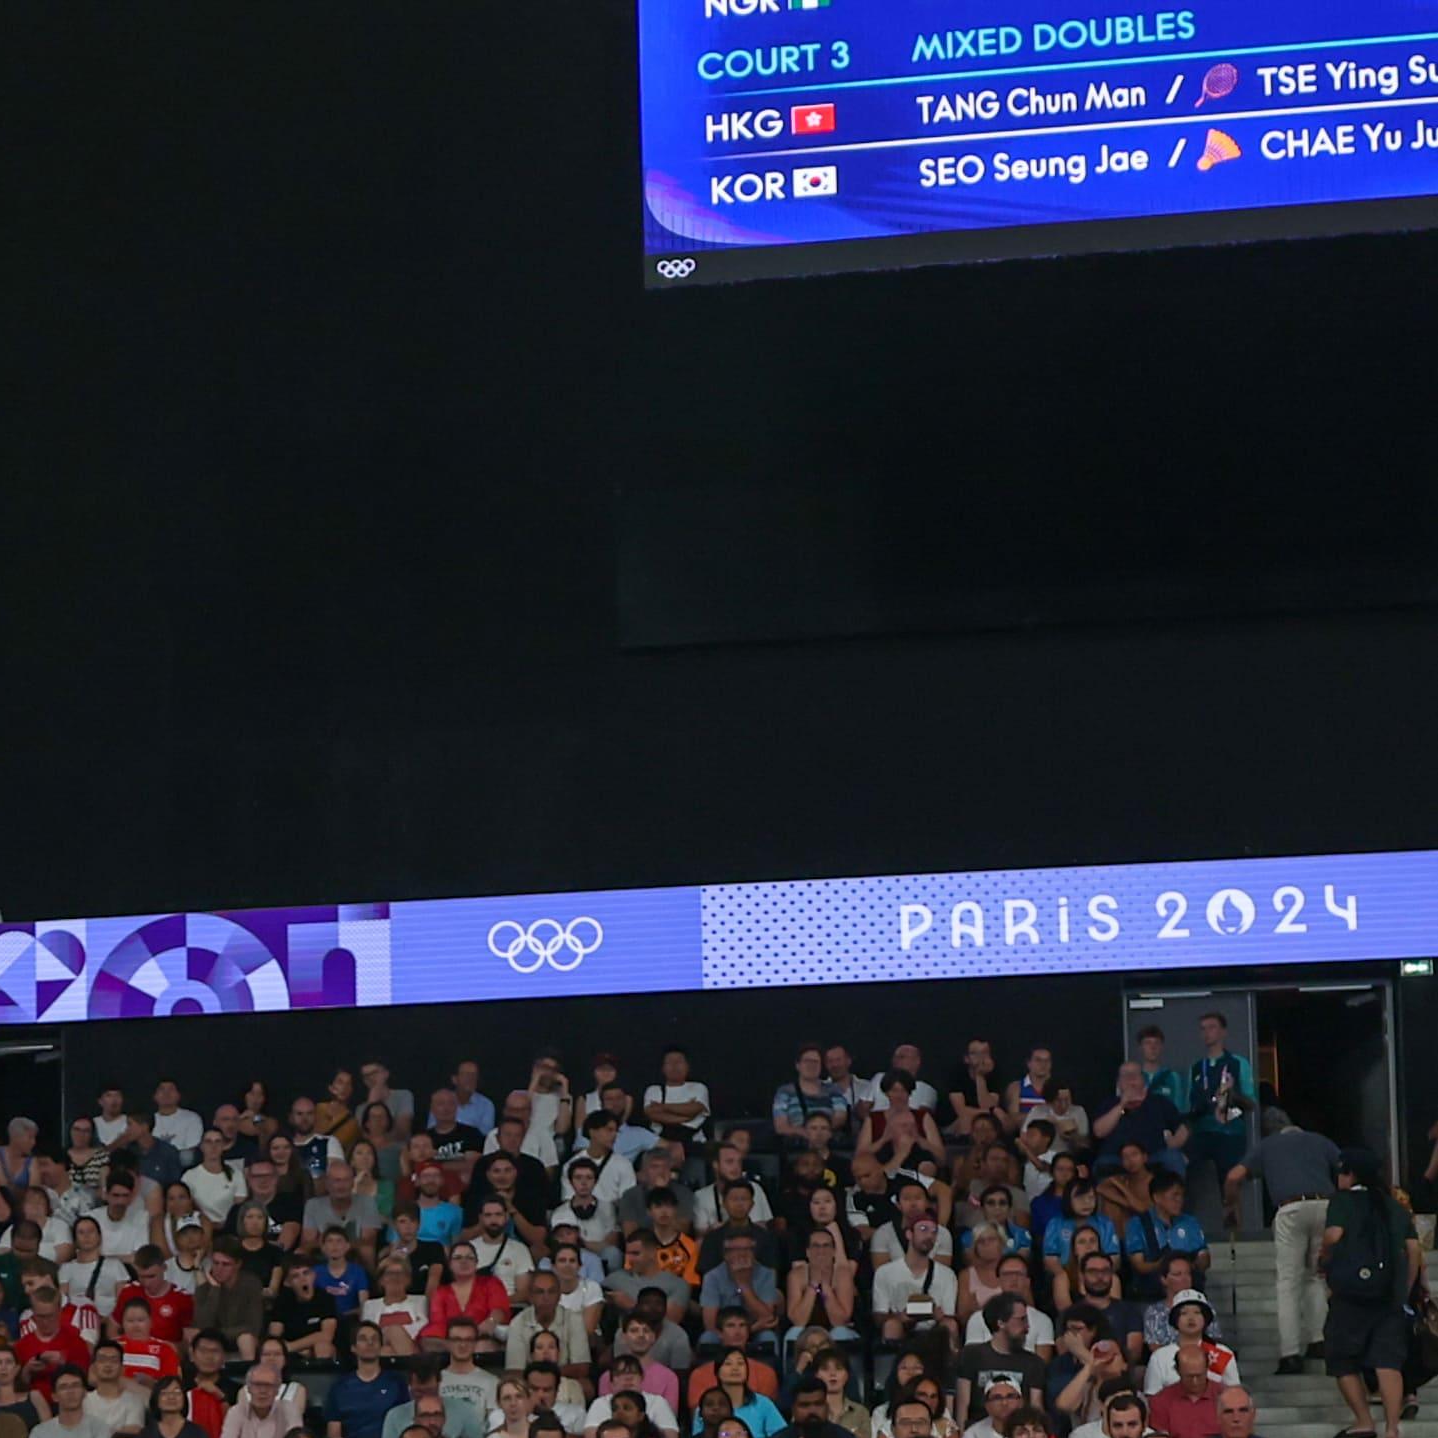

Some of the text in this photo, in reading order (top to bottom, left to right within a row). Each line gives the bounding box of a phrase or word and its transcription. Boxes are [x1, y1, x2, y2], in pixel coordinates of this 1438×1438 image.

[705, 0, 780, 18] NGR
[911, 11, 1195, 62] MIXED DOUBLES
[697, 41, 850, 80] COURT 3
[916, 90, 1000, 124] TANG
[1007, 84, 1082, 117] Chun
[1085, 81, 1146, 109] Man
[1257, 64, 1318, 96] TSE
[1325, 60, 1399, 95] Ying
[706, 109, 784, 143] HKG
[919, 154, 985, 188] SEO
[994, 149, 1086, 185] Seung
[1095, 144, 1149, 174] Jae
[1261, 125, 1356, 161] CHAE
[1362, 122, 1402, 152] Yu
[711, 171, 786, 205] KOR
[1155, 884, 1358, 939] 2024
